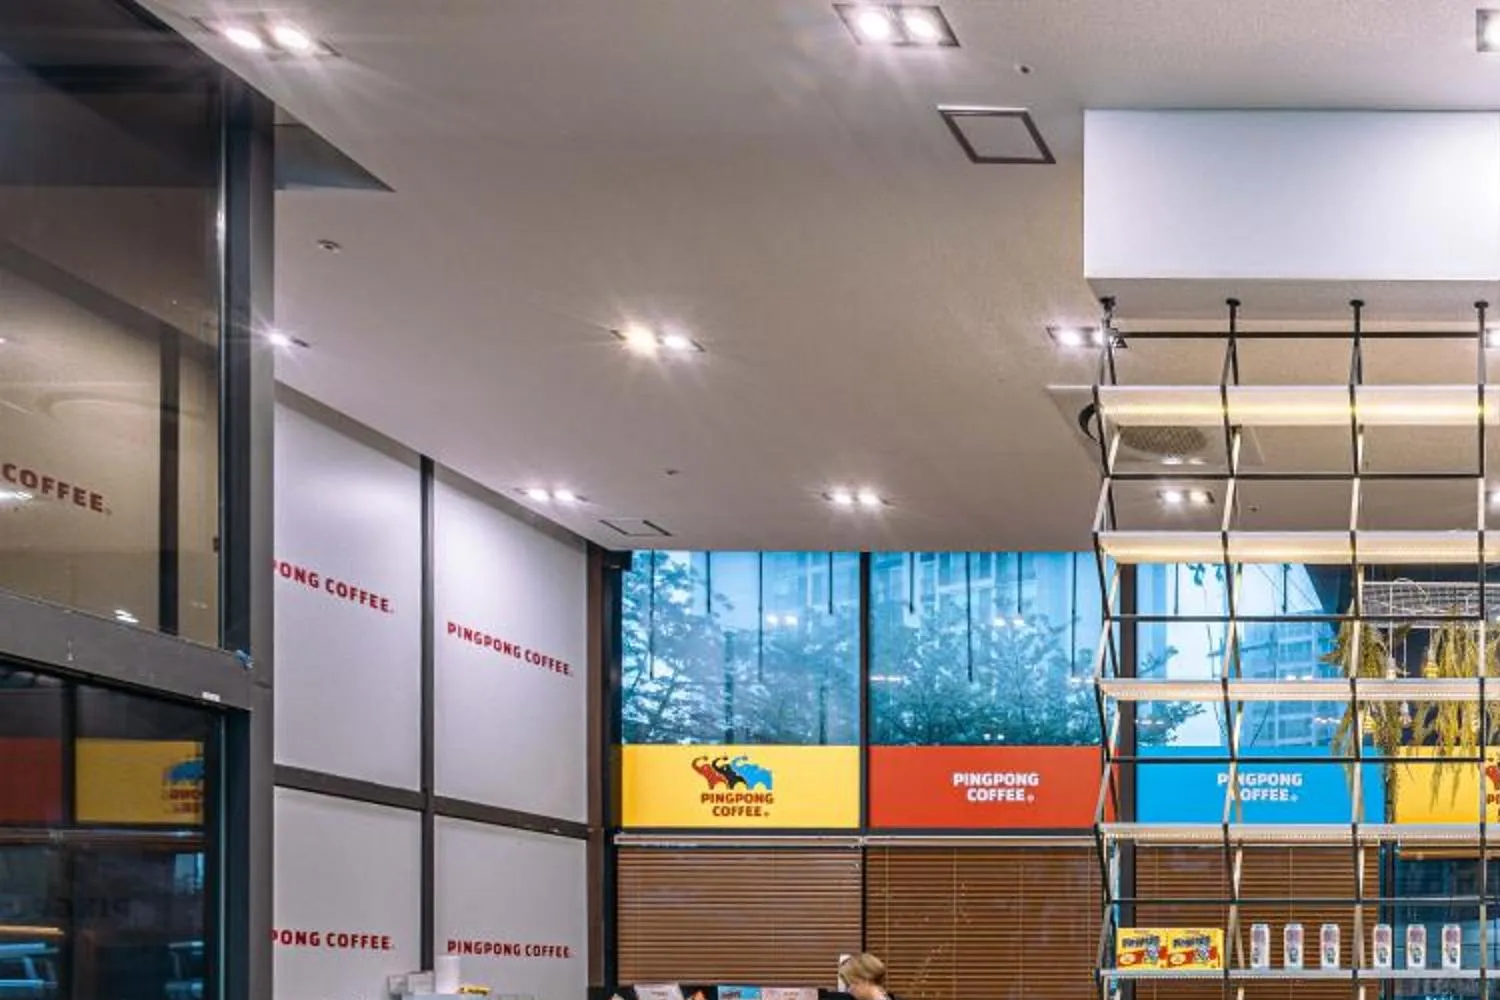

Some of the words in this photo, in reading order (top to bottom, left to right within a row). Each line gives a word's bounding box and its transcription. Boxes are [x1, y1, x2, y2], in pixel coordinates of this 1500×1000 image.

[447, 621, 521, 658] PINGPONG
[953, 773, 1040, 787] PINGPONG
[1217, 773, 1303, 786] PNGPONG
[701, 793, 775, 805] PINGPONG
[448, 940, 520, 956] PINGPONG
